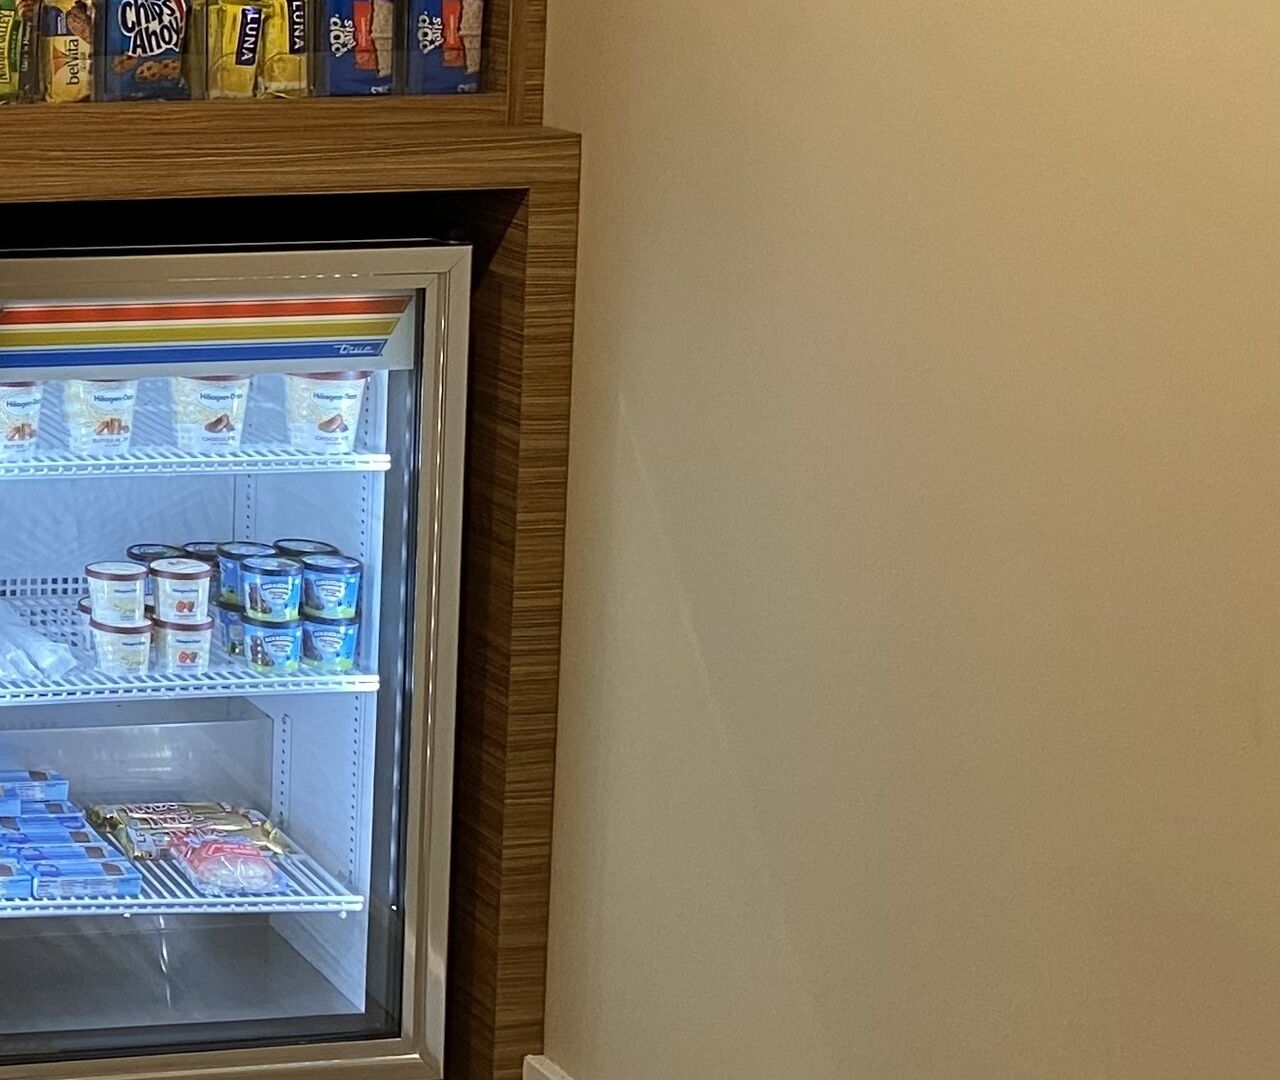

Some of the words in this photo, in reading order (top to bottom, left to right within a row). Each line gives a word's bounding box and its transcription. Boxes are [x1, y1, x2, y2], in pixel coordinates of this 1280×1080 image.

[241, 13, 260, 62] LUNA
[292, 1, 305, 50] LUNA
[66, 39, 80, 86] belVita
[333, 343, 375, 355] true
